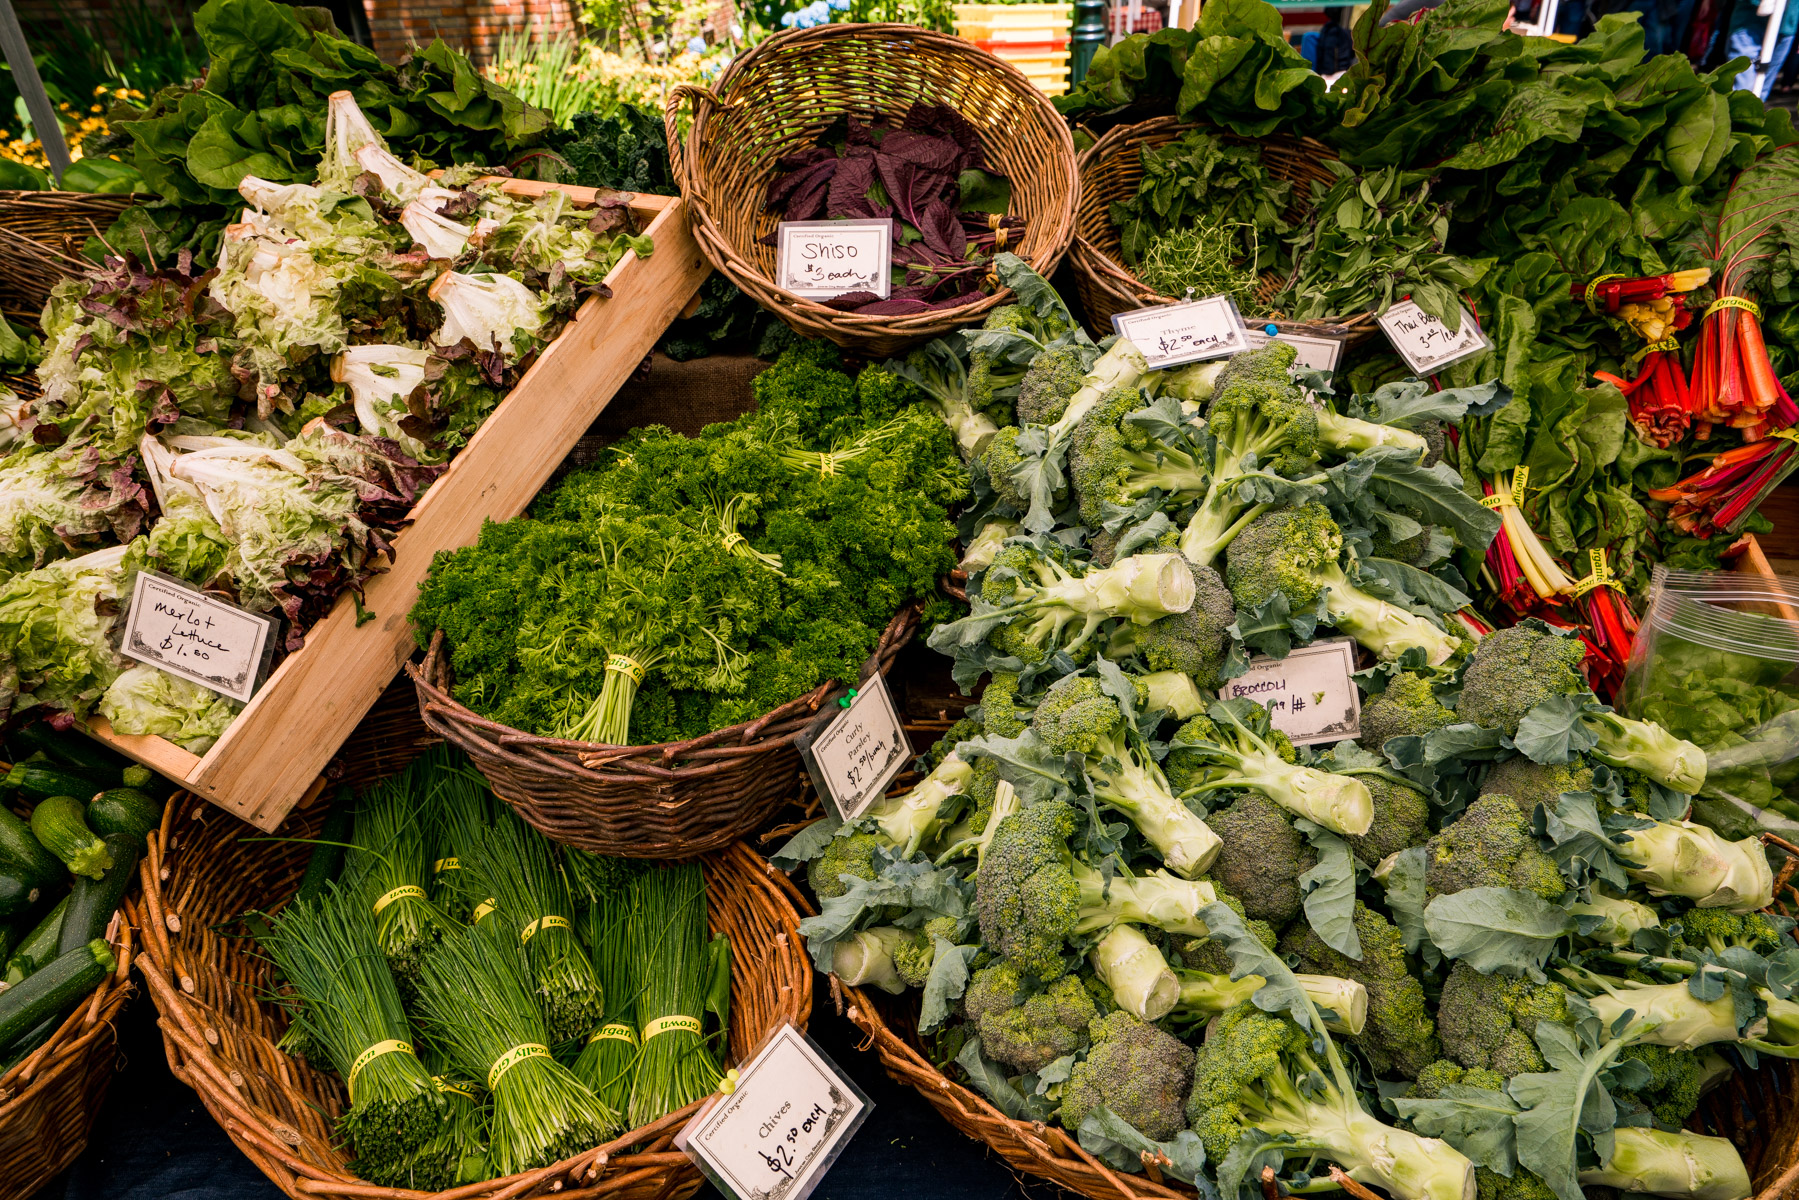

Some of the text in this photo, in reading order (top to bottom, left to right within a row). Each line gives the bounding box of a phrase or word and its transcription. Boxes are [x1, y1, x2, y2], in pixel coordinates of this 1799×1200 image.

[801, 243, 858, 259] Shiso
[827, 268, 867, 281] each
[1417, 311, 1441, 326] Basi
[1160, 325, 1197, 336] Thyme
[1158, 335, 1193, 355] $2.50
[148, 583, 201, 607] Certified Organic
[1256, 661, 1283, 671] Organic
[1231, 679, 1286, 697] BROCCOLI
[820, 719, 849, 753] Certified Organic
[845, 722, 864, 744] Curly
[848, 732, 871, 760] Parsley
[594, 1027, 632, 1038] Organ
[660, 1020, 699, 1031] Grown
[704, 1090, 749, 1142] Certified Organic
[758, 1100, 792, 1139] Chives
[758, 1127, 799, 1180] $2.50
[802, 1102, 827, 1134] EACH
